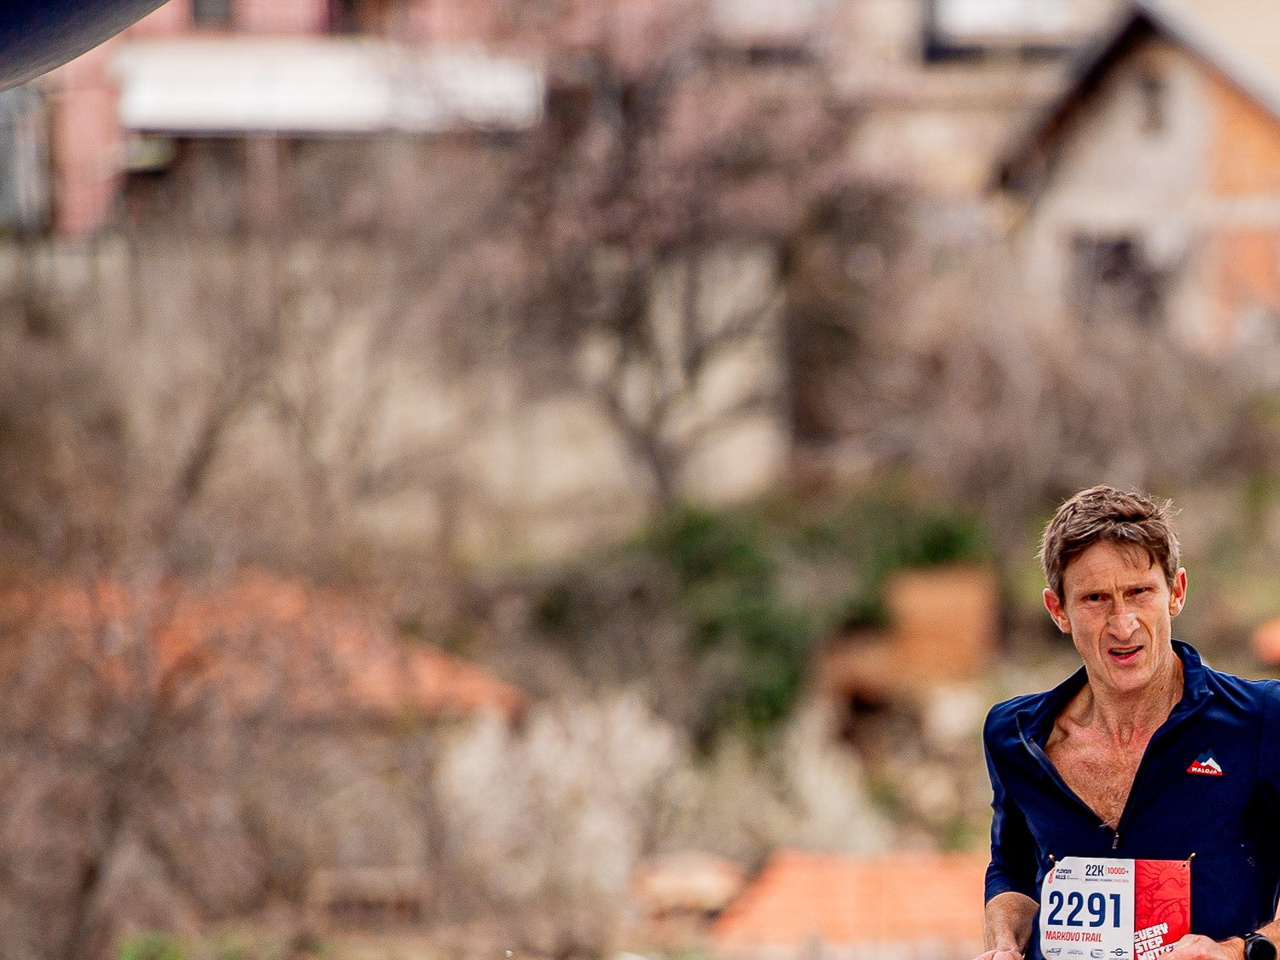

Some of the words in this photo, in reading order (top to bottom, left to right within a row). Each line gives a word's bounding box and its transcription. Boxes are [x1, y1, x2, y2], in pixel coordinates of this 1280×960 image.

[1085, 864, 1104, 876] 22K
[1047, 890, 1121, 928] 2291
[1045, 930, 1080, 942] MARKOVO
[1081, 932, 1102, 943] TRAIL
[1134, 922, 1169, 942] EVERY
[1135, 936, 1164, 954] STEP
